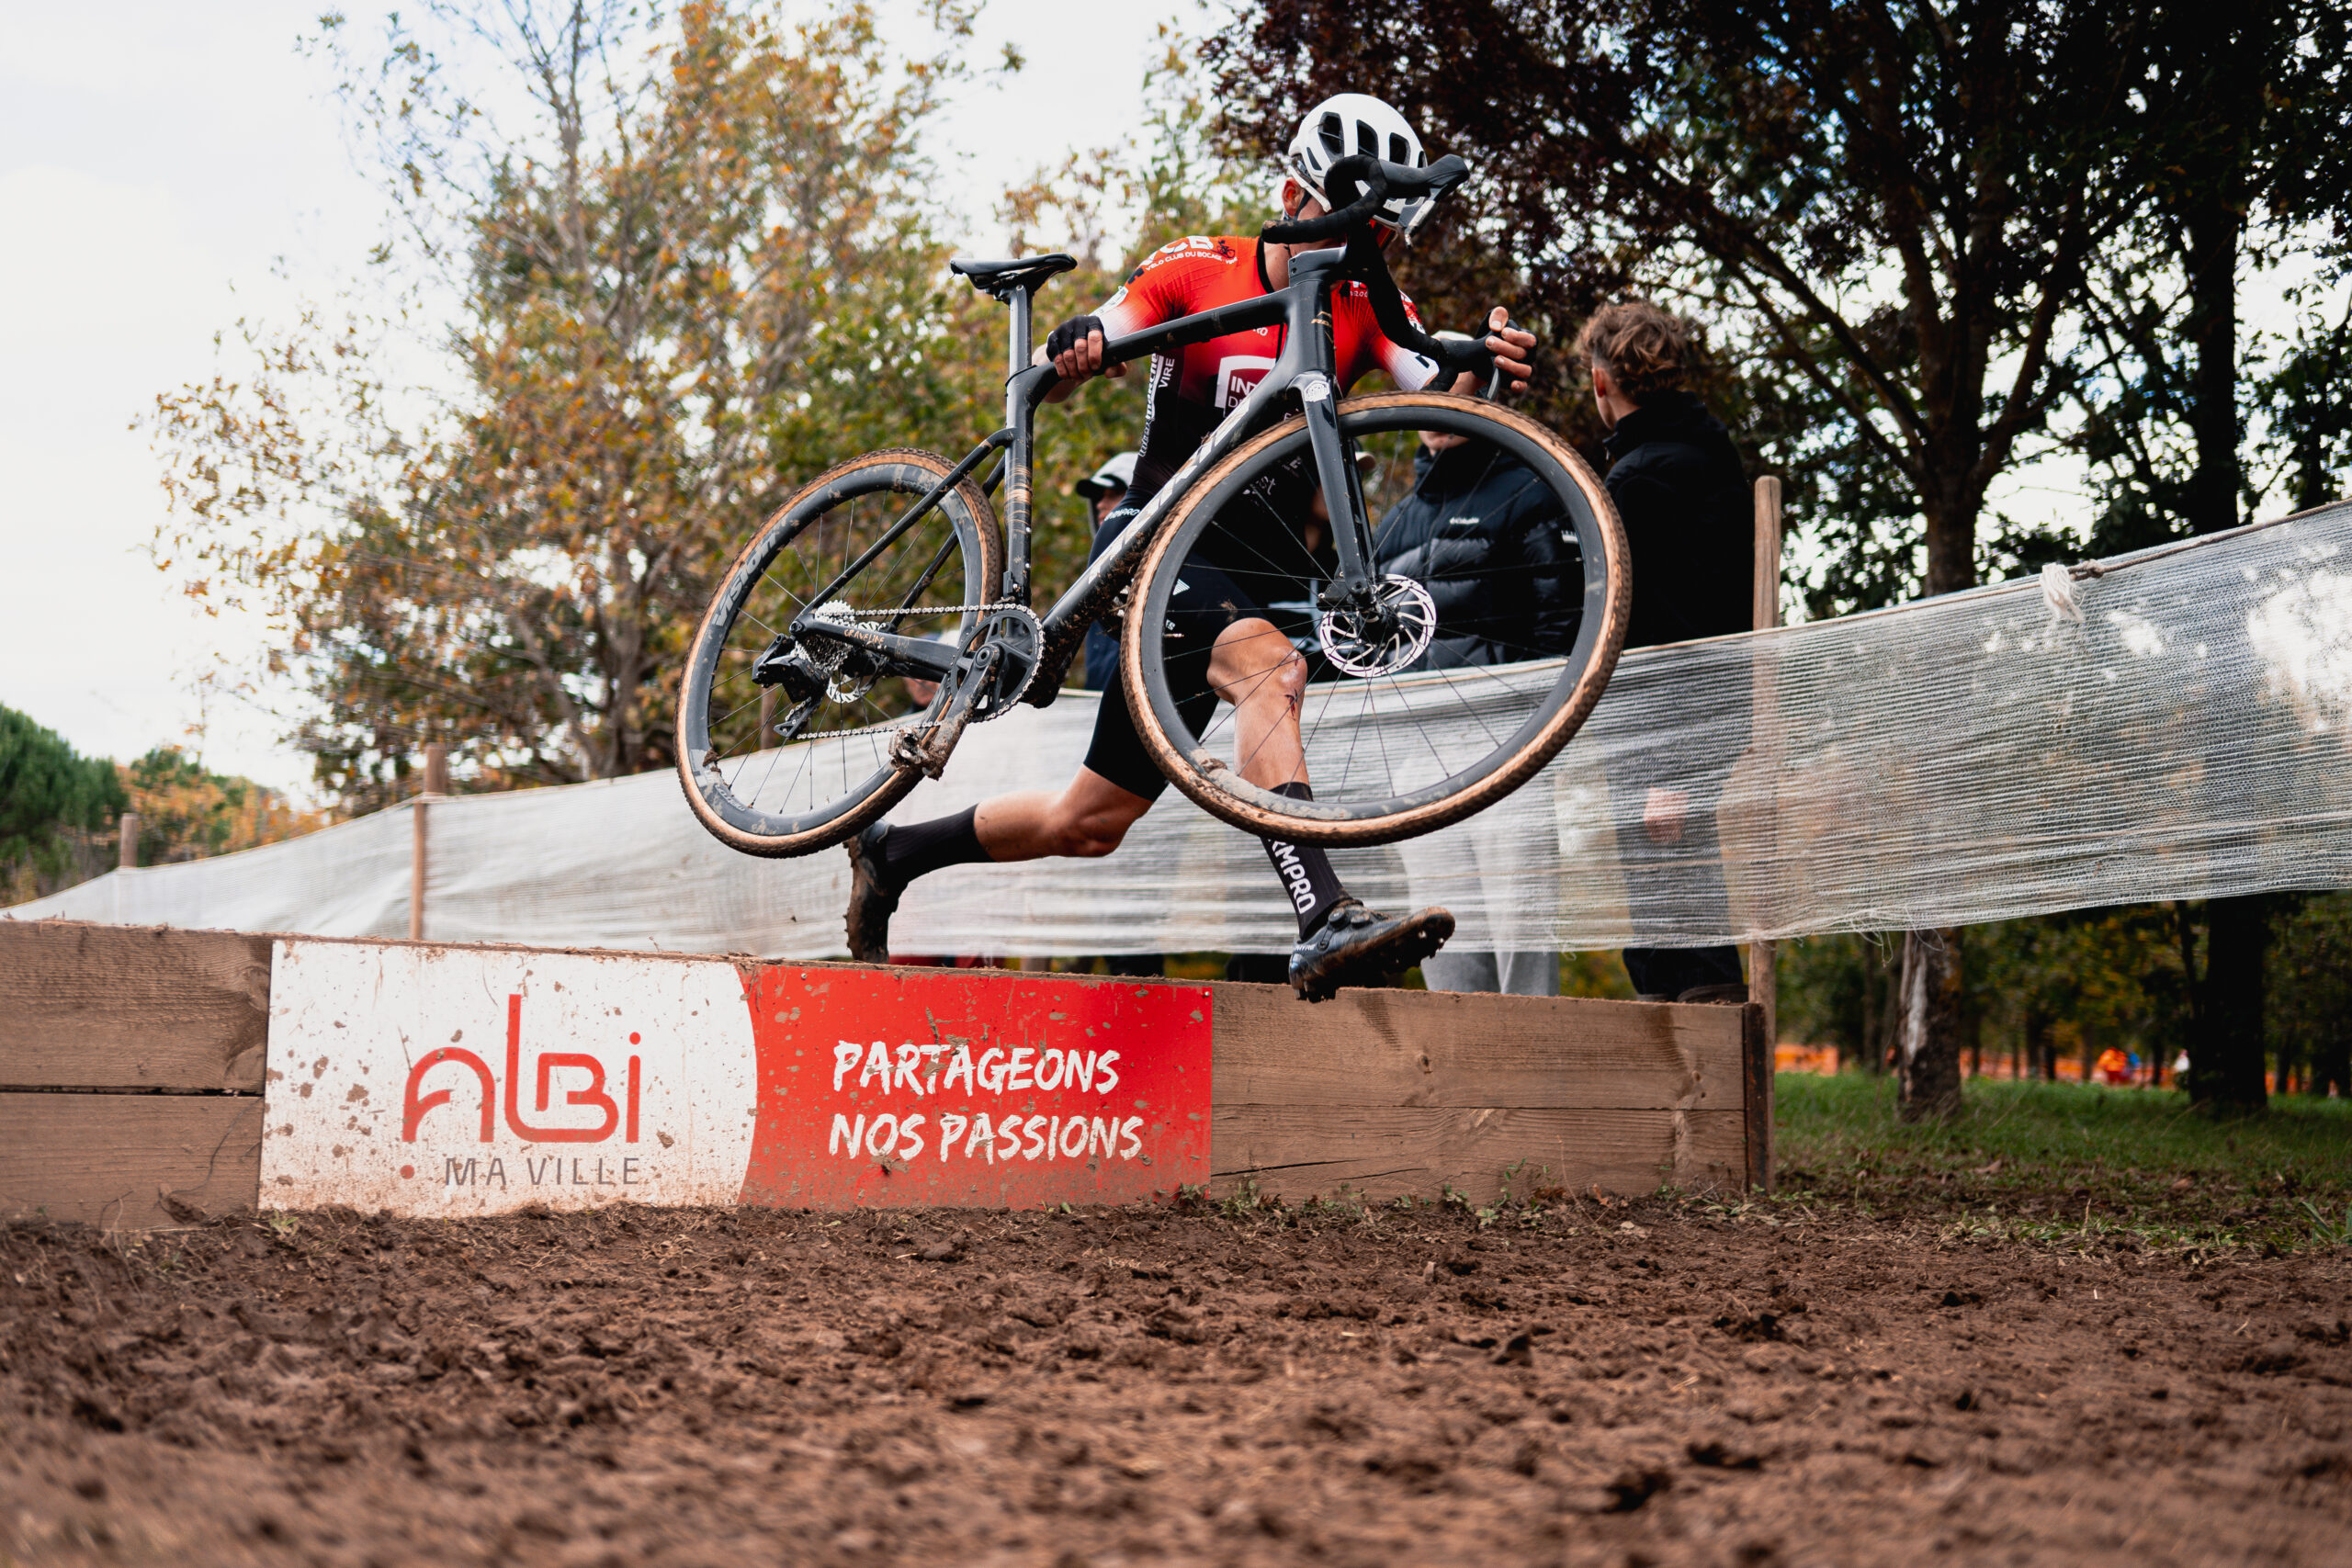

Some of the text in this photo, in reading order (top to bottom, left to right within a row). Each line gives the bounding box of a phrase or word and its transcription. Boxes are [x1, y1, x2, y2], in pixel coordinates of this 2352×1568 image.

[1185, 250, 1196, 258] DU
[1158, 357, 1175, 388] VIRE
[832, 1039, 1121, 1097] PARTAGEONS
[828, 1111, 1144, 1166] NOS PASSIONS
[445, 1157, 639, 1186] MA VILLE
